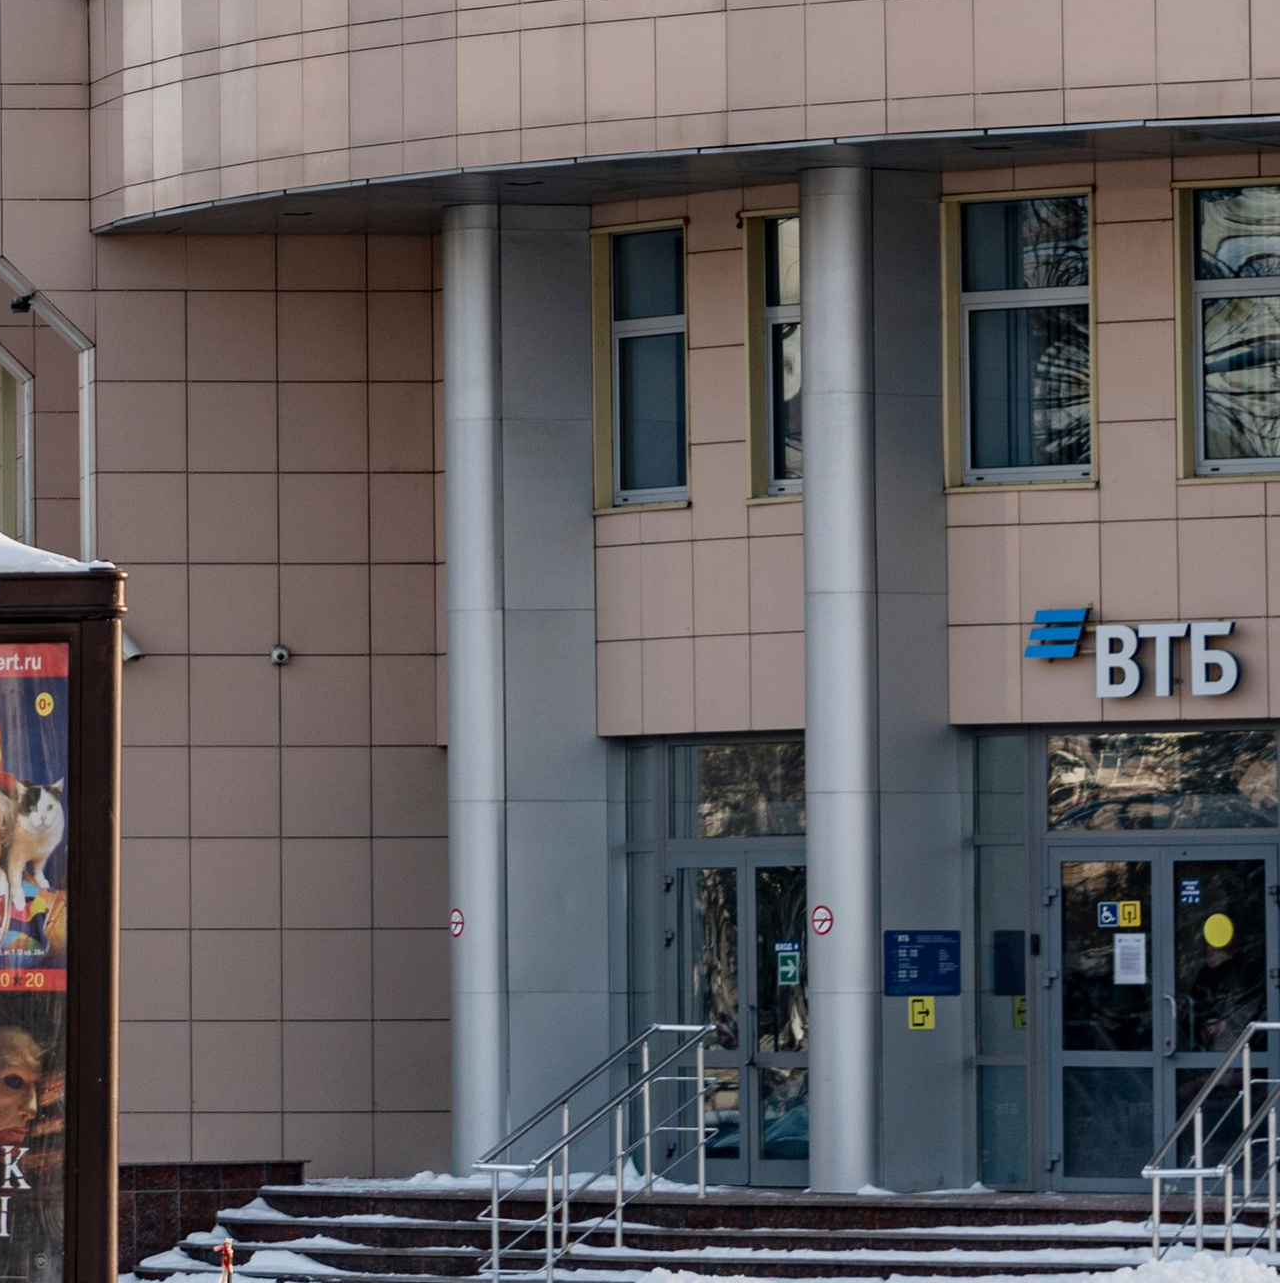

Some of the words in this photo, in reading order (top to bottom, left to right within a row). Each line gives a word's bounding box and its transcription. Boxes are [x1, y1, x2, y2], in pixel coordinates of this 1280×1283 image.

[1096, 622, 1241, 698] ВТБ
[38, 698, 52, 710] 0+
[25, 972, 44, 988] 20
